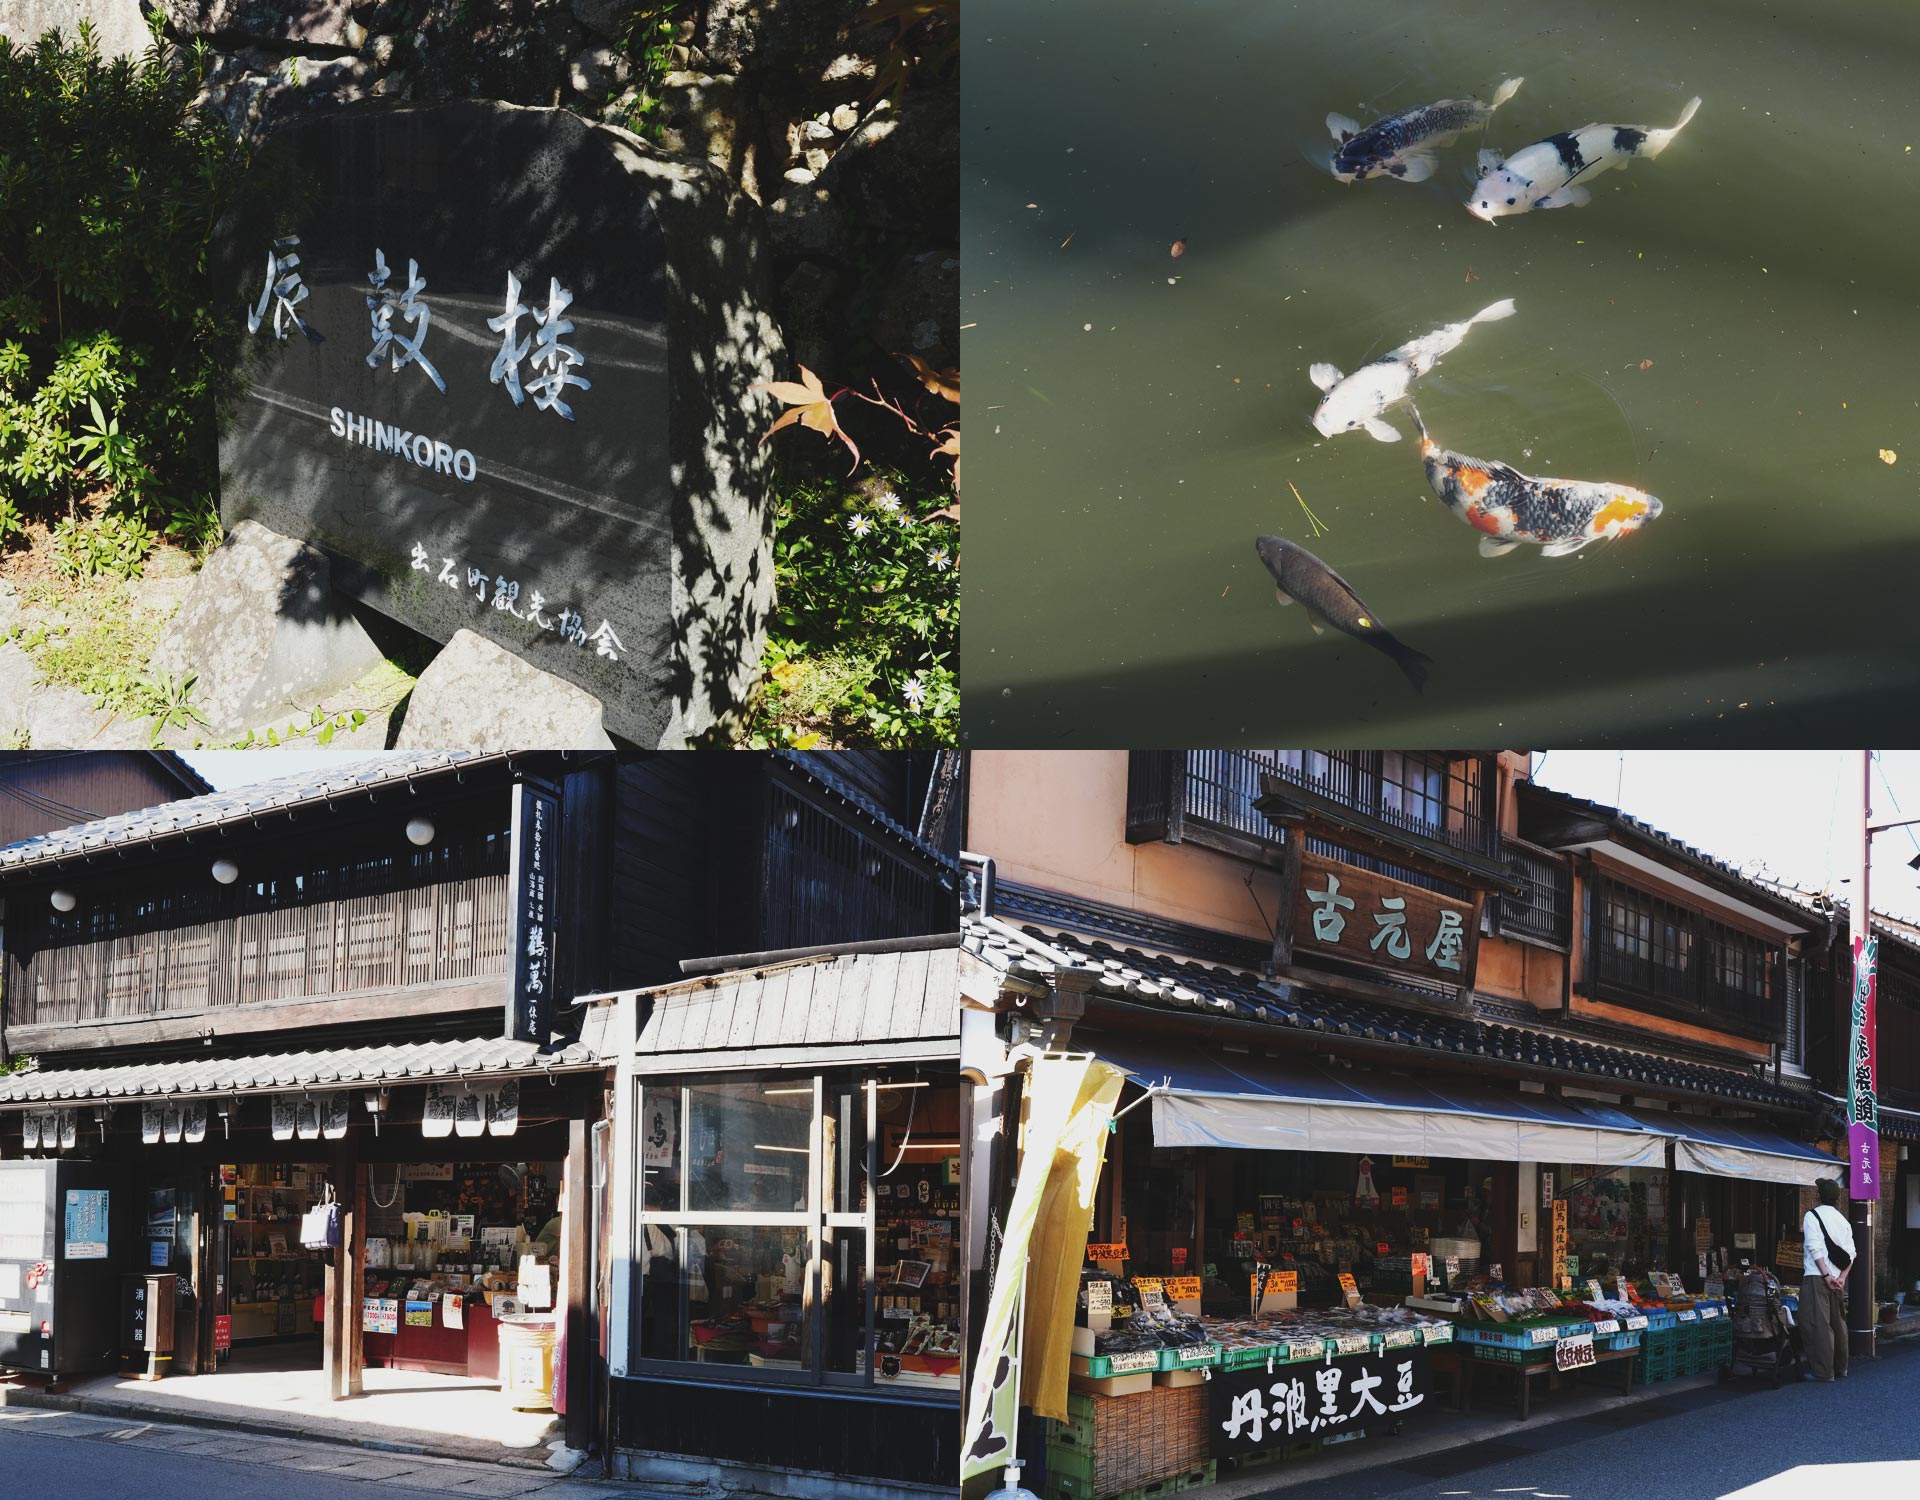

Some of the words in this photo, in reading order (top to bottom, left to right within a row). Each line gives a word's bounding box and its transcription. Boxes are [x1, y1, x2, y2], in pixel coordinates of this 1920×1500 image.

[247, 234, 592, 422] 辰鼓楼
[329, 406, 477, 484] SHINKORO
[410, 541, 627, 661] 出石町観光協会
[1305, 872, 1464, 972] 古元屋
[134, 1288, 145, 1342] 消火器
[1221, 1360, 1424, 1443] 丹波黒大豆
